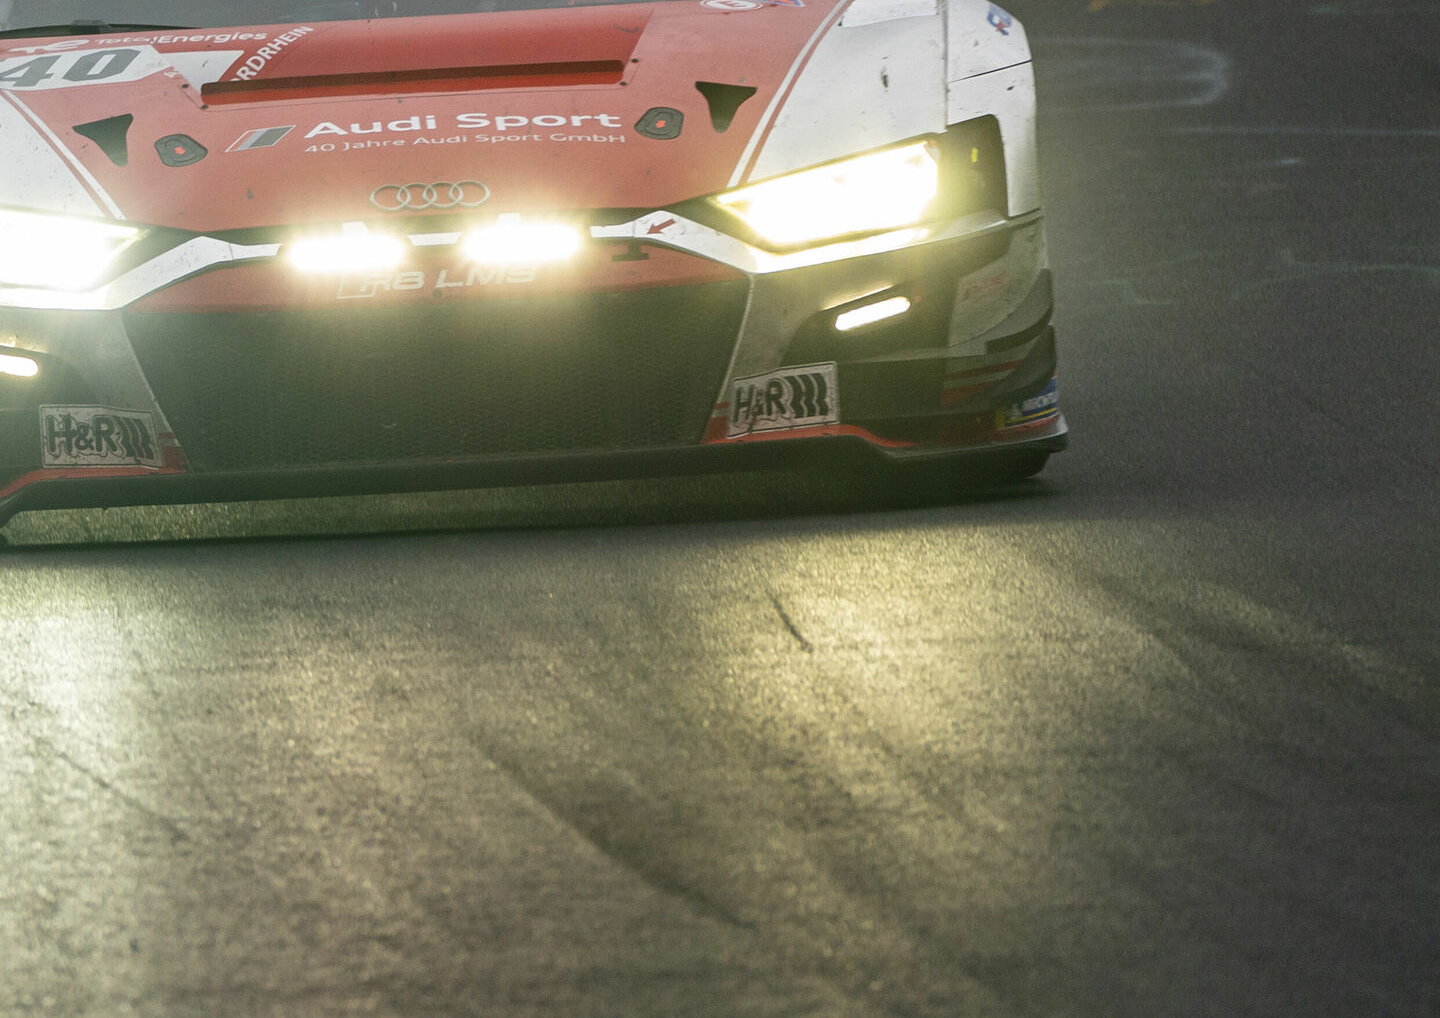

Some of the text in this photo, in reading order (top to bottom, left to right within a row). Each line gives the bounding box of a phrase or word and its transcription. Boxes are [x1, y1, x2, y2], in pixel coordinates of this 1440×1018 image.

[230, 25, 315, 82] RDRHEIN
[304, 112, 622, 139] Audi Sport
[304, 132, 626, 153] 40 Jahre Audi Sport GmbH
[435, 266, 537, 289] LMS
[732, 379, 788, 425] H&R
[44, 413, 120, 456] H&R
